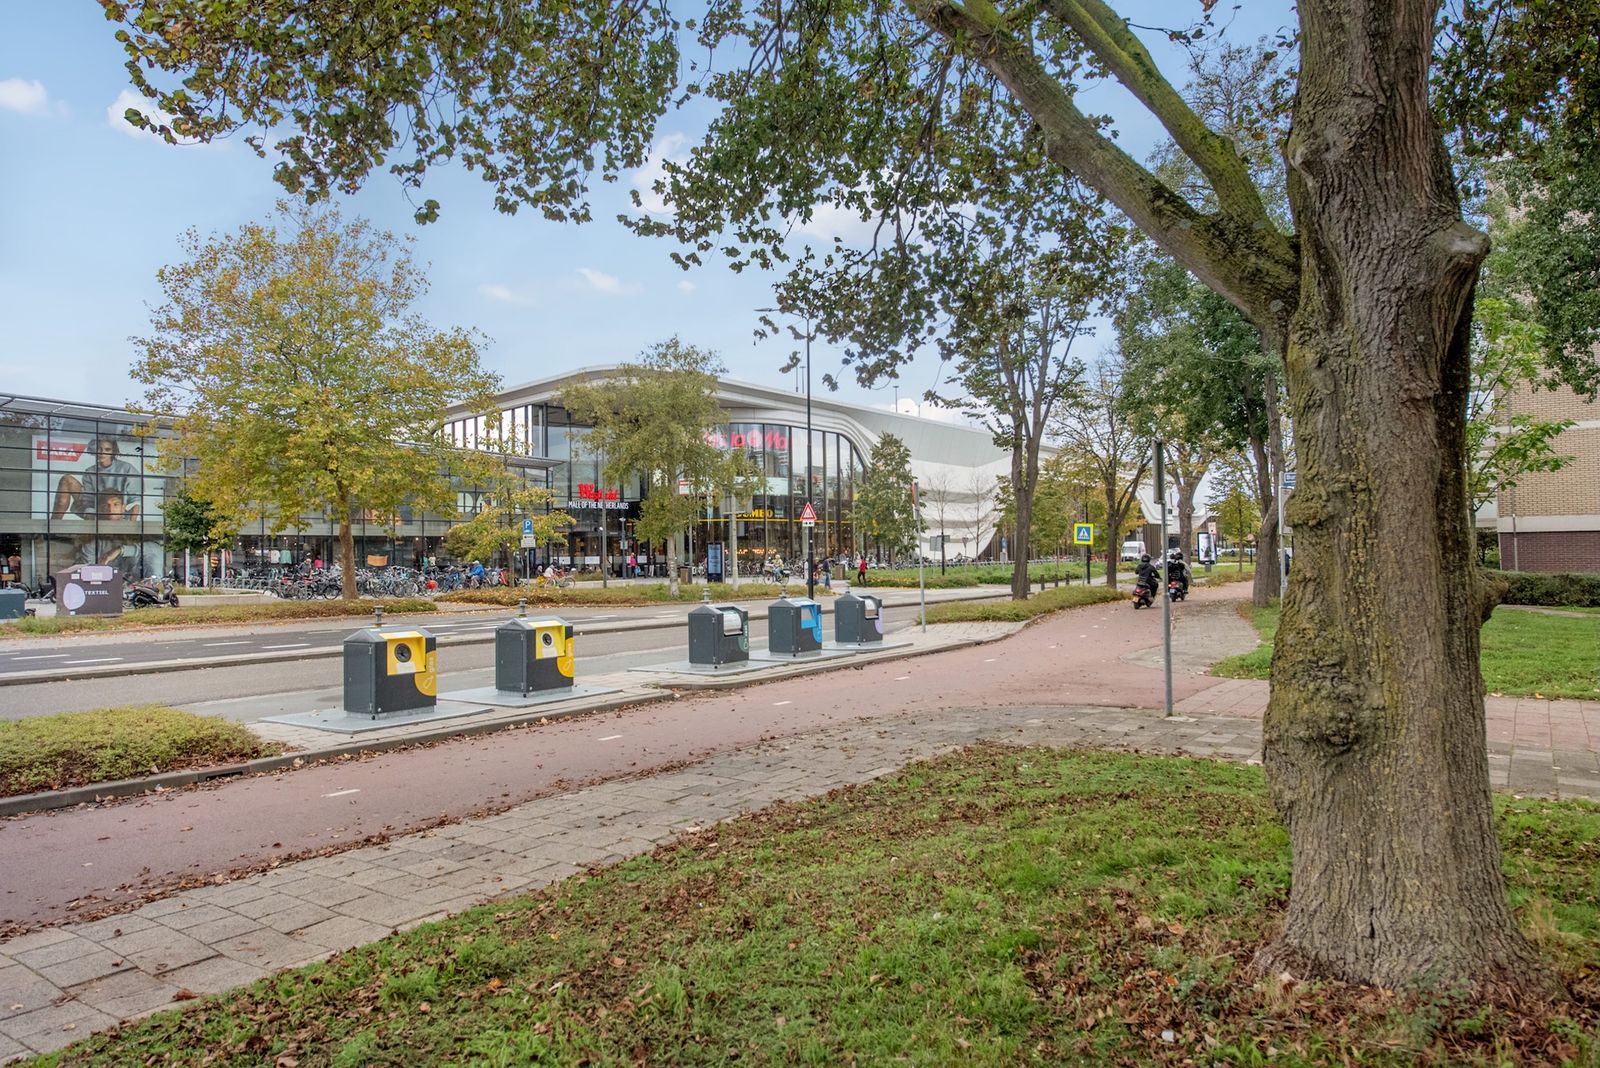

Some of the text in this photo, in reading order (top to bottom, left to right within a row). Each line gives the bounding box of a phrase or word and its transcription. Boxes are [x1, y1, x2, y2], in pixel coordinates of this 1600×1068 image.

[577, 483, 619, 500] Westeld
[568, 501, 581, 509] MALL
[598, 501, 629, 510] NEHERLANDS
